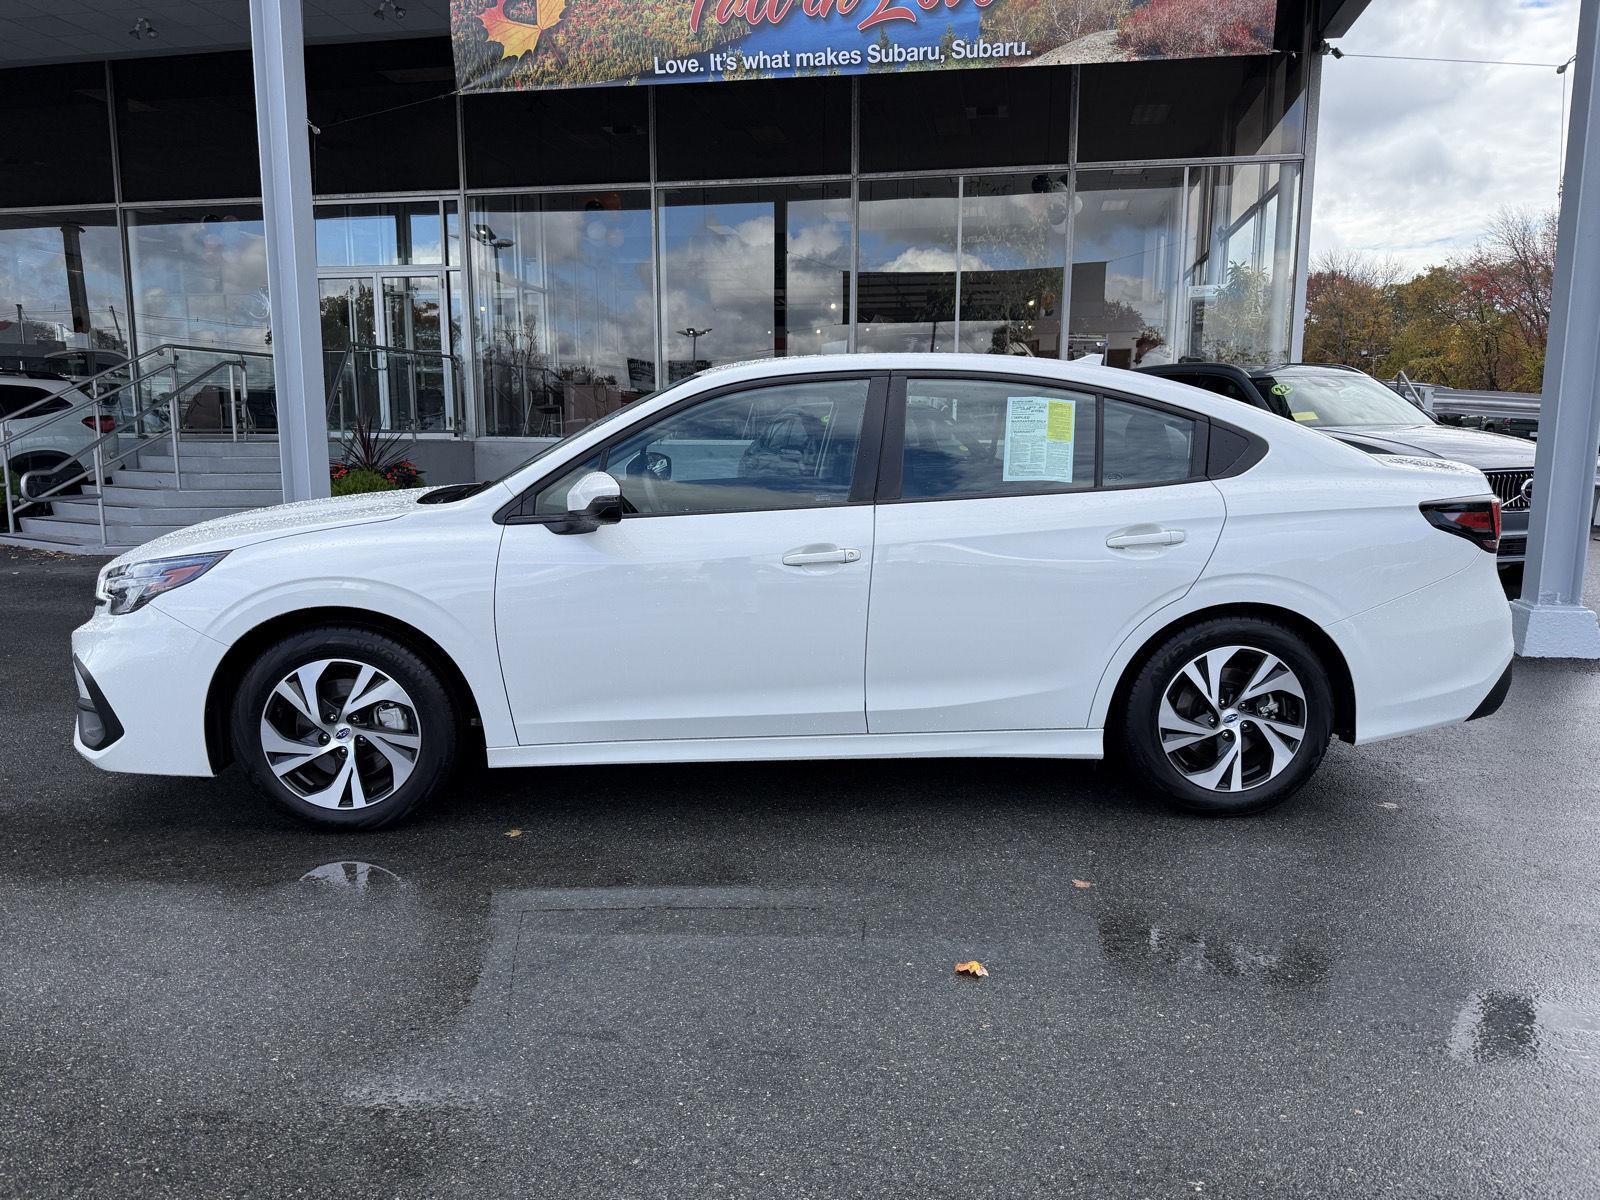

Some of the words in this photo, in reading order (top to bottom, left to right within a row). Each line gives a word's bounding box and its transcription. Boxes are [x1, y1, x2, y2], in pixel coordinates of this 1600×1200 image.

[654, 57, 704, 75] Love.
[710, 53, 737, 72] It's
[744, 50, 791, 69] what
[796, 47, 862, 67] makes
[867, 44, 946, 64] Subaru,
[952, 39, 1032, 59] Subaru.
